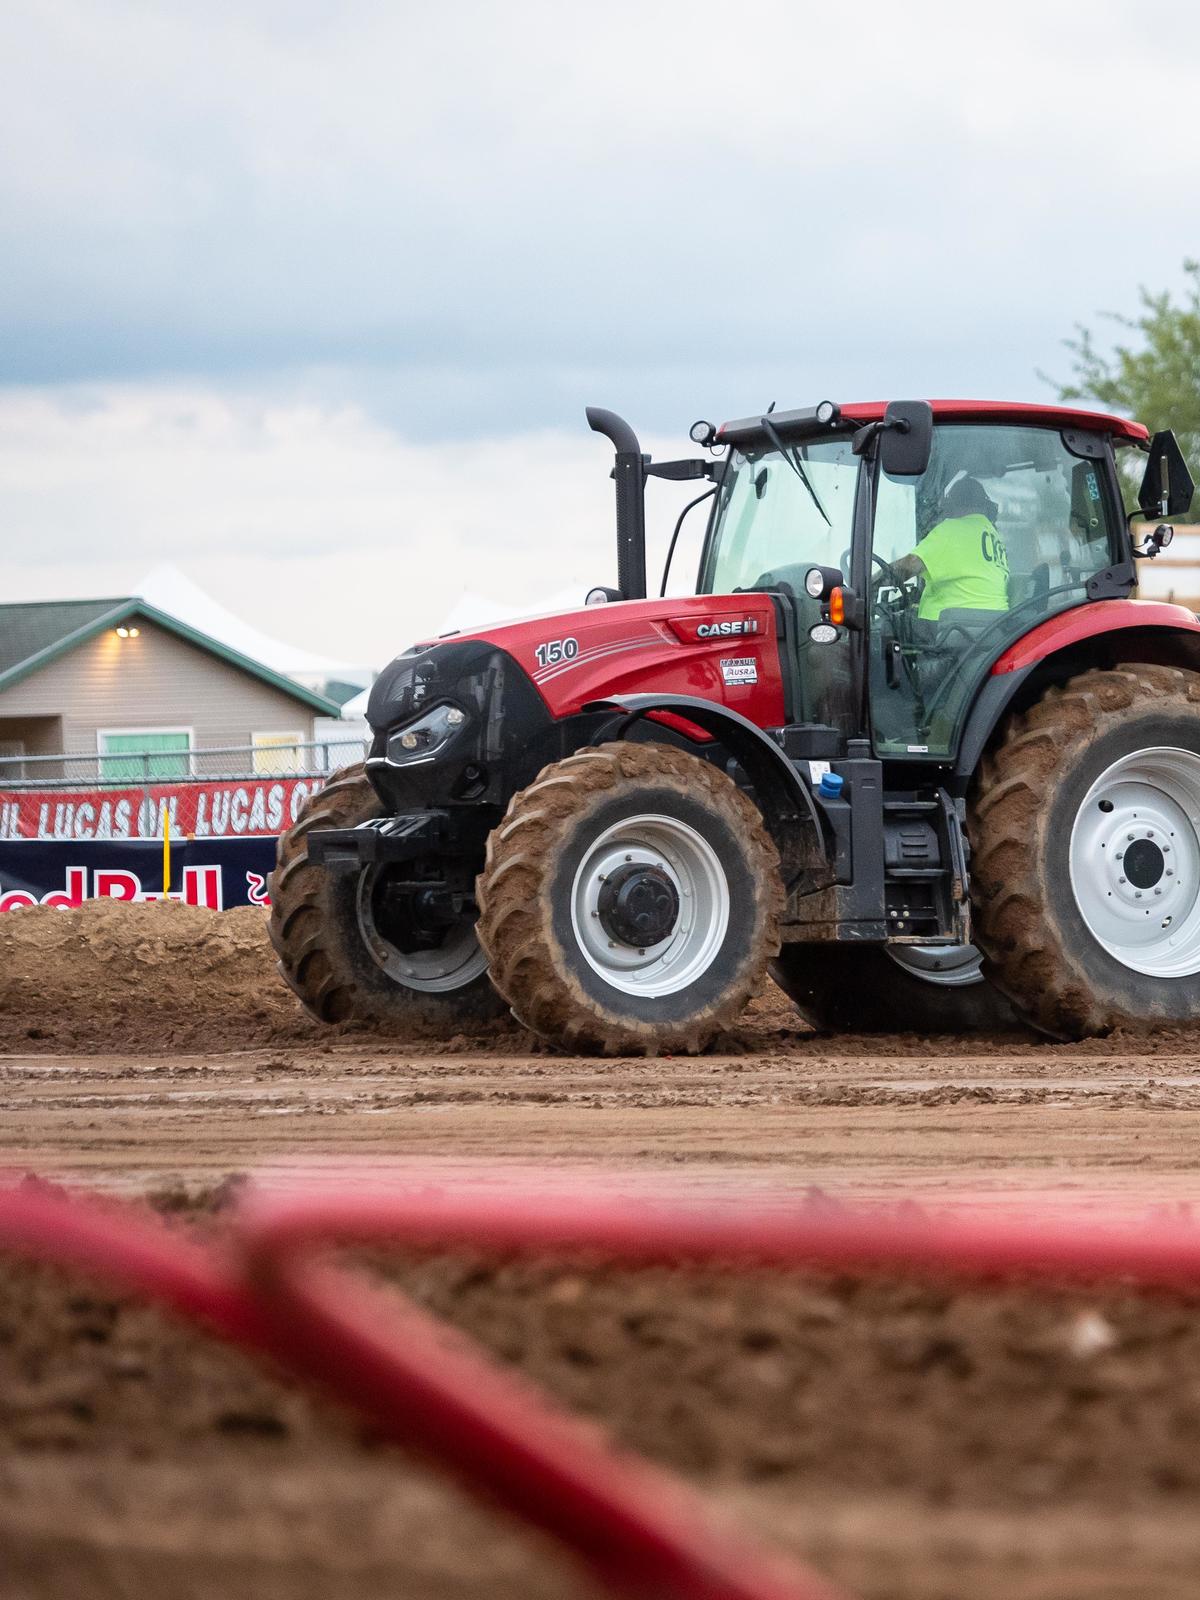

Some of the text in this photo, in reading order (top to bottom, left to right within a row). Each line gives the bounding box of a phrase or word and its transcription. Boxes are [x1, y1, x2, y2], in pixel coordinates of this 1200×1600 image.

[697, 622, 742, 637] CASE
[535, 637, 578, 667] 150
[0, 802, 23, 839] IL
[37, 799, 132, 839] LUCAS
[195, 784, 285, 836] LUCAS
